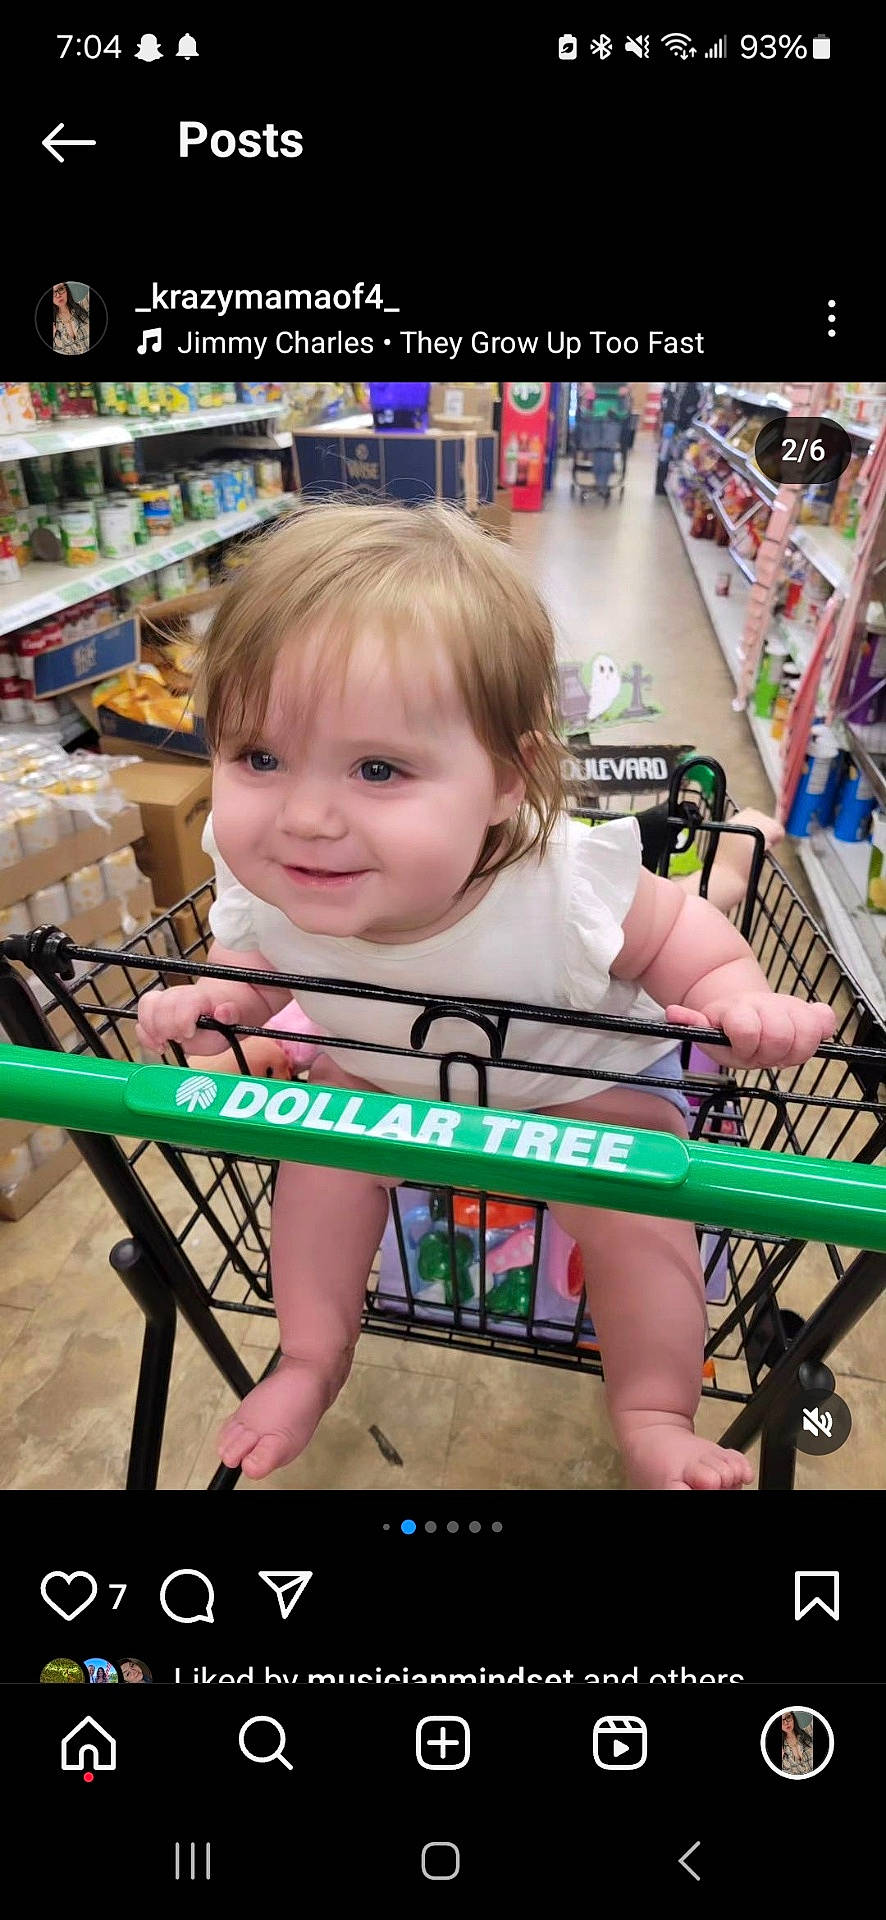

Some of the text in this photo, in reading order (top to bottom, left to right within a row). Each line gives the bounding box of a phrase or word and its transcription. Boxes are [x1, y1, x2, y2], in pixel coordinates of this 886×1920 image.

[560, 757, 669, 781] OULEVARD
[219, 1081, 635, 1173] DOLLAR TREE
